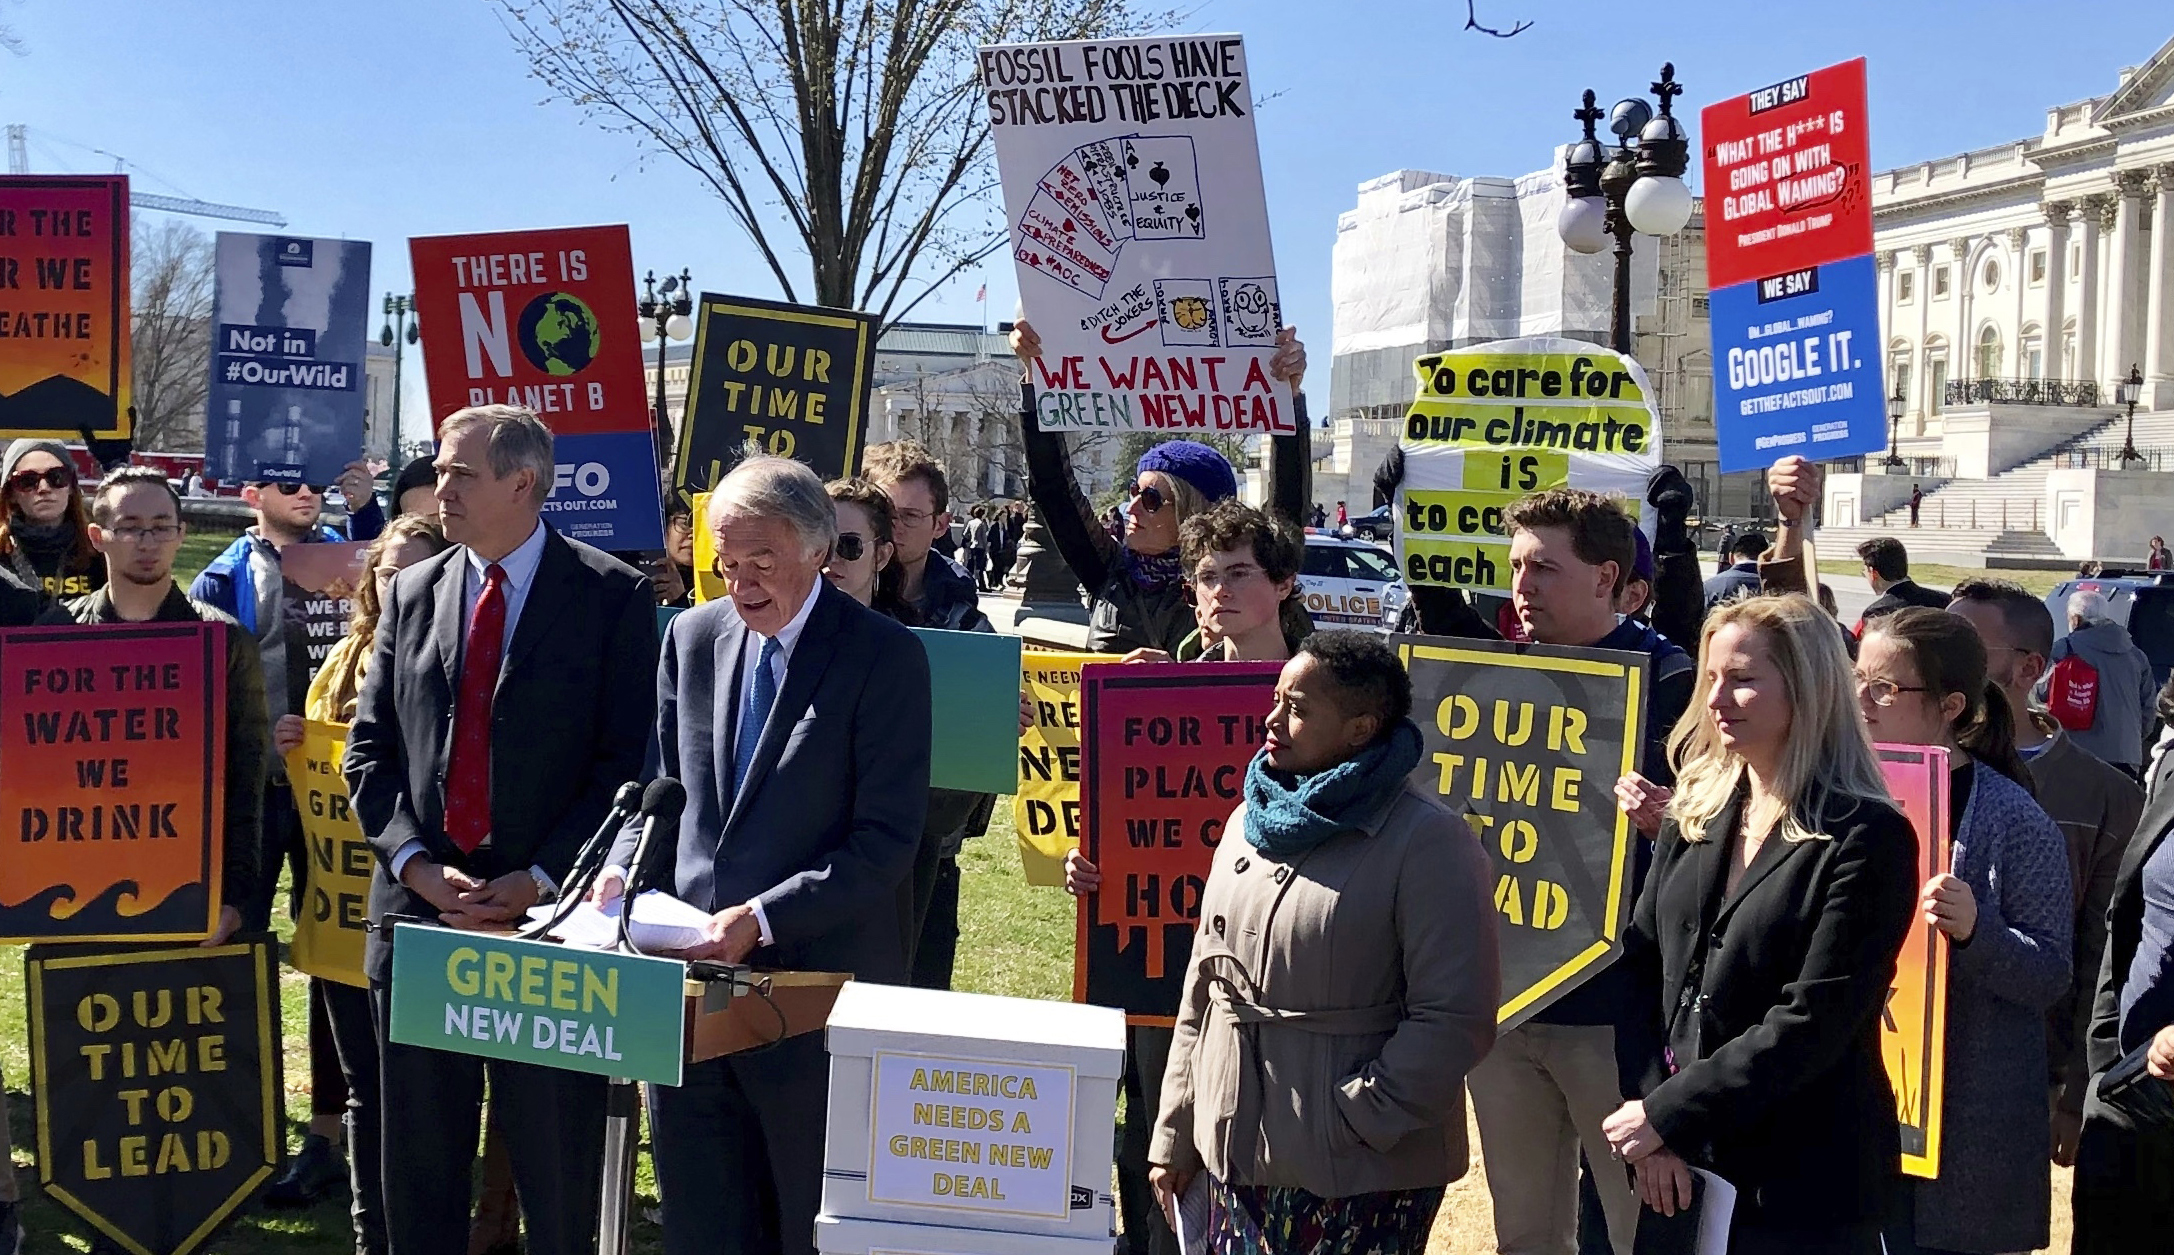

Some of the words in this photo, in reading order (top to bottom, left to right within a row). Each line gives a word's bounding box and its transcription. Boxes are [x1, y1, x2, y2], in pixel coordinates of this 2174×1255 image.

[980, 47, 1073, 87] FOSSIL
[1083, 44, 1164, 81] FOOLS
[1169, 40, 1241, 78] HAVE
[988, 84, 1107, 125] STACKED
[1108, 83, 1160, 124] THE
[1161, 80, 1245, 119] DECK
[1750, 86, 1780, 113] THEY
[1782, 77, 1808, 102] SAY
[1758, 128, 1784, 155] THE
[1829, 110, 1845, 135] IS
[1056, 164, 1080, 183] NET
[1731, 161, 1768, 191] GOING
[1772, 155, 1791, 180] ON
[1794, 143, 1831, 173] WITH
[1060, 178, 1088, 206] ZERO
[1130, 192, 1185, 202] JUSTICE
[1724, 189, 1774, 221] GLOBAL
[29, 209, 92, 237] THE
[1028, 209, 1076, 246] CLIMATE
[1064, 197, 1114, 247] EMISSIONS
[1136, 217, 1184, 233] EQUITY
[1737, 227, 1776, 247] PRESIDENT
[1777, 220, 1806, 238] DONALD
[1806, 213, 1833, 230] TRUMP
[35, 257, 92, 290] WE
[451, 252, 547, 287] THERE
[558, 250, 588, 282] IS
[1045, 255, 1081, 286] #AOC
[1764, 277, 1784, 300] WE
[1786, 271, 1812, 293] SAY
[1121, 283, 1146, 306] THE
[1114, 297, 1154, 331] JOKERS
[229, 329, 276, 352] Not
[283, 331, 306, 354] in
[226, 361, 347, 388] #OurWild
[727, 339, 831, 384] OUR
[1035, 357, 1091, 392] WE
[1099, 356, 1225, 392] WANT
[1243, 357, 1272, 394] A
[1419, 357, 1455, 395] To
[1467, 368, 1561, 397] care
[1570, 357, 1636, 398] for
[1728, 336, 1822, 391] GOOGLE
[1828, 330, 1862, 373] IT.
[587, 382, 604, 410] B
[723, 380, 827, 425] TIME
[1038, 392, 1133, 428] GREEN
[1139, 394, 1206, 429] NEW
[1211, 395, 1295, 431] DEAL
[1740, 382, 1853, 416] GETTHEFACTSOUT.COM
[743, 424, 796, 459] TO
[1407, 413, 1476, 441] our
[1484, 407, 1643, 452] climate
[1500, 456, 1538, 490] is
[1407, 497, 1447, 532] to
[1407, 546, 1495, 586] each
[305, 600, 333, 615] WE
[306, 622, 334, 637] WE
[24, 667, 95, 694] FOR
[110, 663, 180, 691] THE
[1038, 670, 1080, 684] NEED
[24, 707, 180, 744] WATER
[1125, 715, 1200, 746] FOR
[1436, 694, 1588, 755] OUR
[76, 759, 129, 788] WE
[306, 757, 330, 775] WE
[1432, 752, 1583, 813] TIME
[20, 803, 178, 842] DRINK
[1126, 818, 1183, 848] WE
[1463, 812, 1539, 864] TO
[446, 947, 618, 1018] GREEN
[77, 986, 225, 1032] OUR
[444, 1002, 523, 1045] NEW
[532, 1015, 622, 1061] DEAL
[79, 1035, 227, 1080] TIME
[910, 1068, 1038, 1100] AMERICA
[118, 1086, 193, 1125] TO
[913, 1102, 1004, 1132] NEEDS
[1011, 1111, 1032, 1134] A
[84, 1131, 230, 1180] LEAD
[889, 1135, 980, 1165] GREEN
[988, 1143, 1054, 1170] NEW
[932, 1172, 1006, 1201] DEAL
